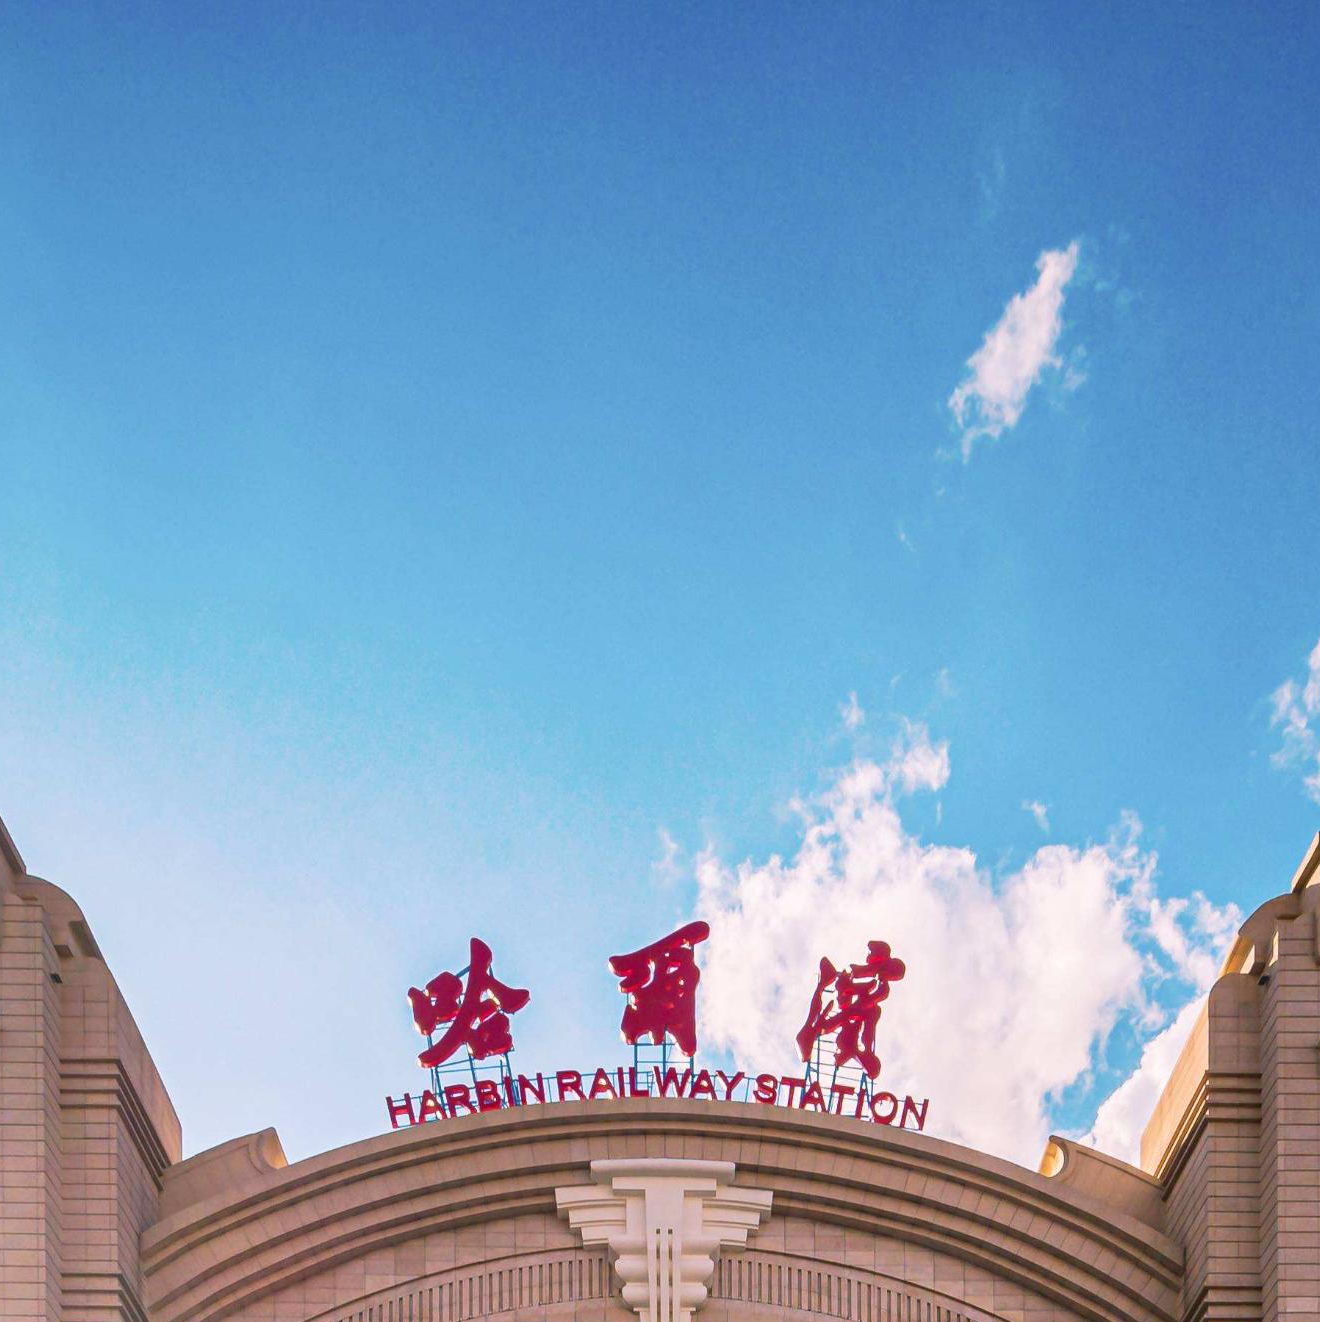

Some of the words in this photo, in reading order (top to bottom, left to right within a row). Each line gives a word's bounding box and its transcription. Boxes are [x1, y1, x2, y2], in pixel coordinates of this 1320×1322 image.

[386, 1074, 547, 1129] HARBIN
[556, 1065, 745, 1101] RAILWAY
[753, 1073, 929, 1131] STATION
